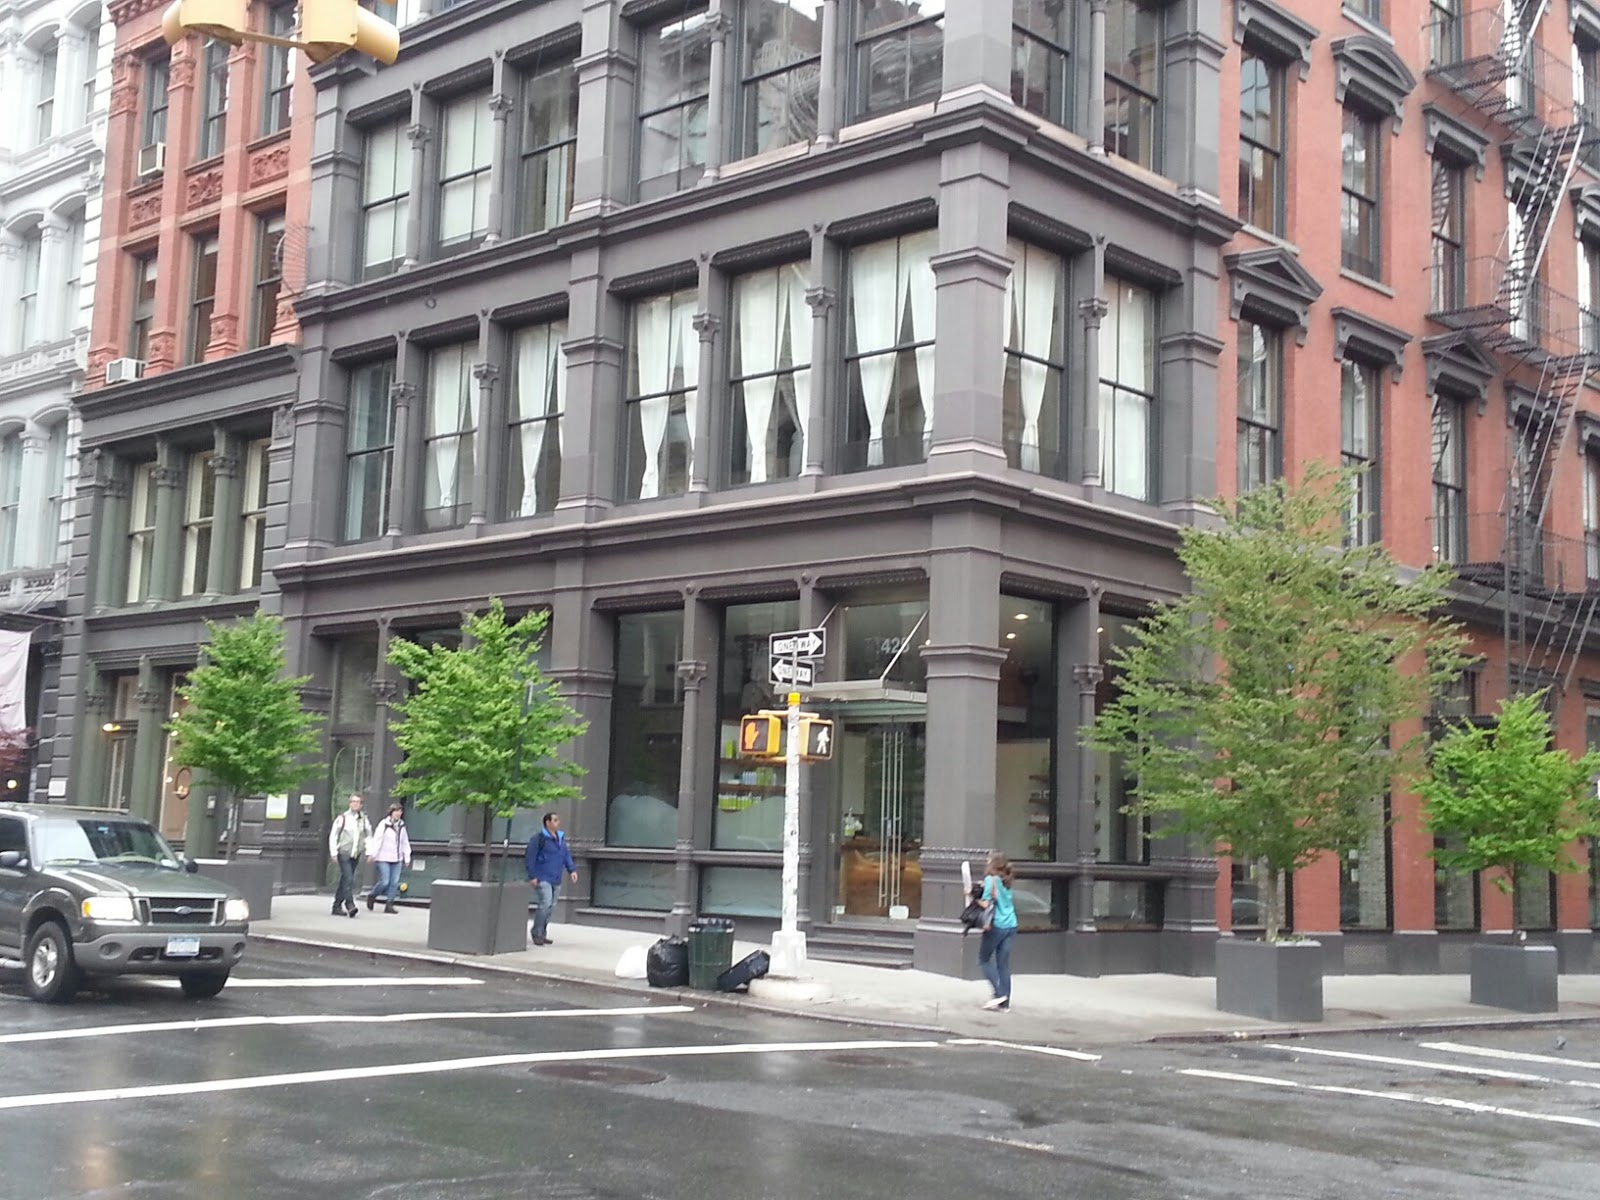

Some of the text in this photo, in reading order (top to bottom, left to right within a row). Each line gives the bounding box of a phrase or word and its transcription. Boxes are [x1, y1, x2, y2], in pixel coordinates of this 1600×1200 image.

[778, 638, 817, 652] ONE WAY
[778, 665, 793, 679] ONE
